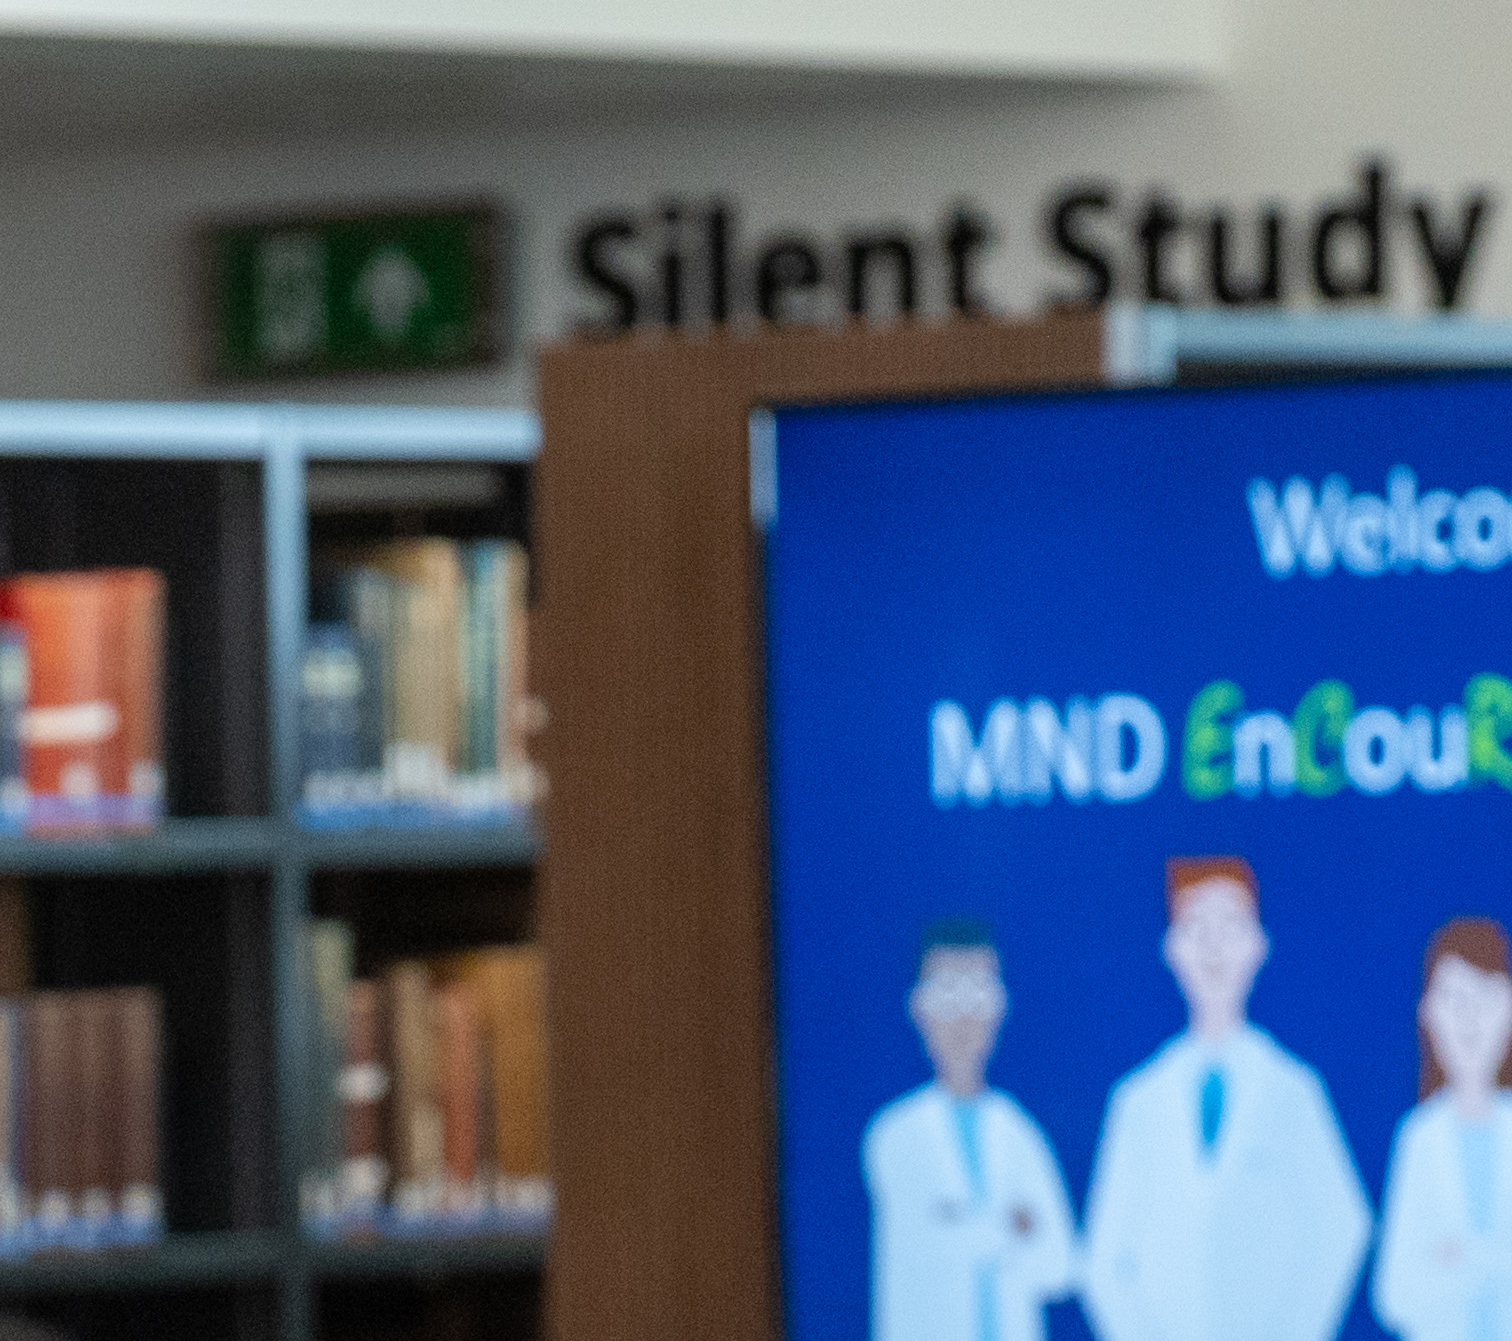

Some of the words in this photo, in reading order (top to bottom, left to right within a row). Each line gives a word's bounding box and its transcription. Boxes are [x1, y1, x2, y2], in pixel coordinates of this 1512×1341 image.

[568, 193, 988, 330] Silent
[1048, 152, 1488, 316] Study
[931, 693, 1167, 806] MND
